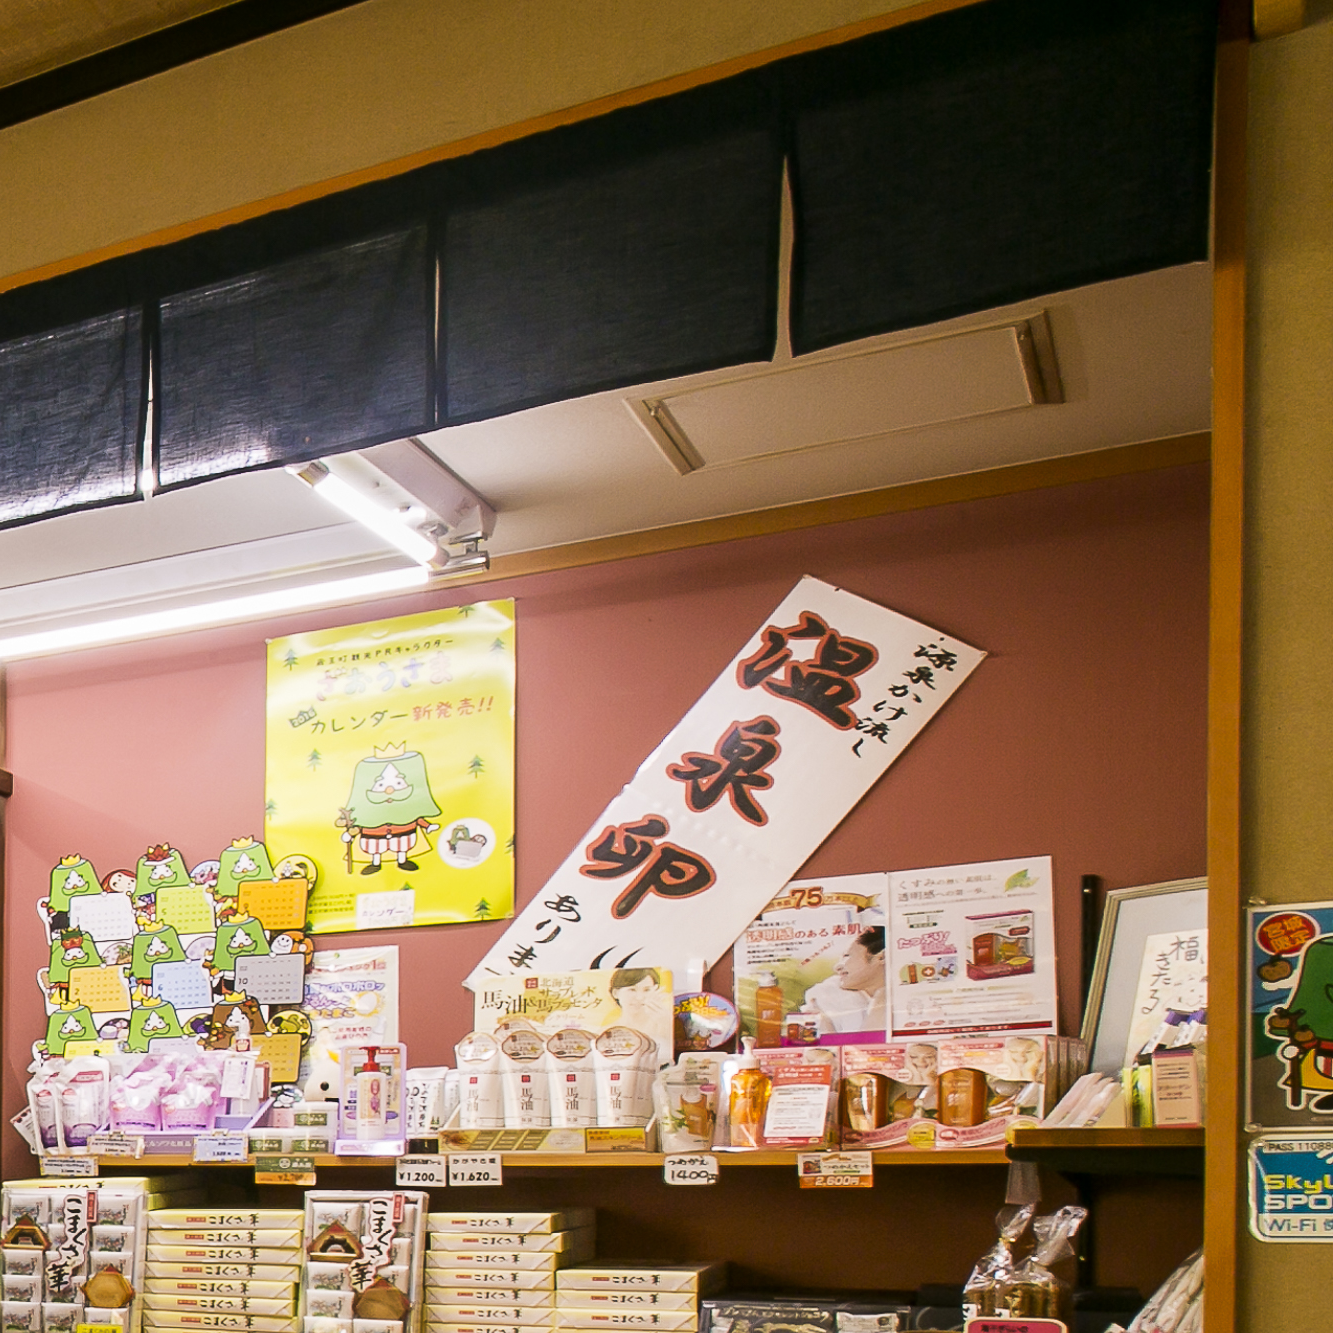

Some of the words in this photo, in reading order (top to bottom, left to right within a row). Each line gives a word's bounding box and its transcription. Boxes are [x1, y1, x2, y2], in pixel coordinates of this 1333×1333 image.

[853, 641, 959, 759] 源泉かけ流し
[311, 709, 409, 735] カレンダー
[579, 610, 879, 920] 温泉卵
[790, 886, 824, 909] 75
[482, 893, 581, 976] ありま
[481, 990, 527, 1015] 馬油
[1264, 1218, 1317, 1233] Wi-Fi
